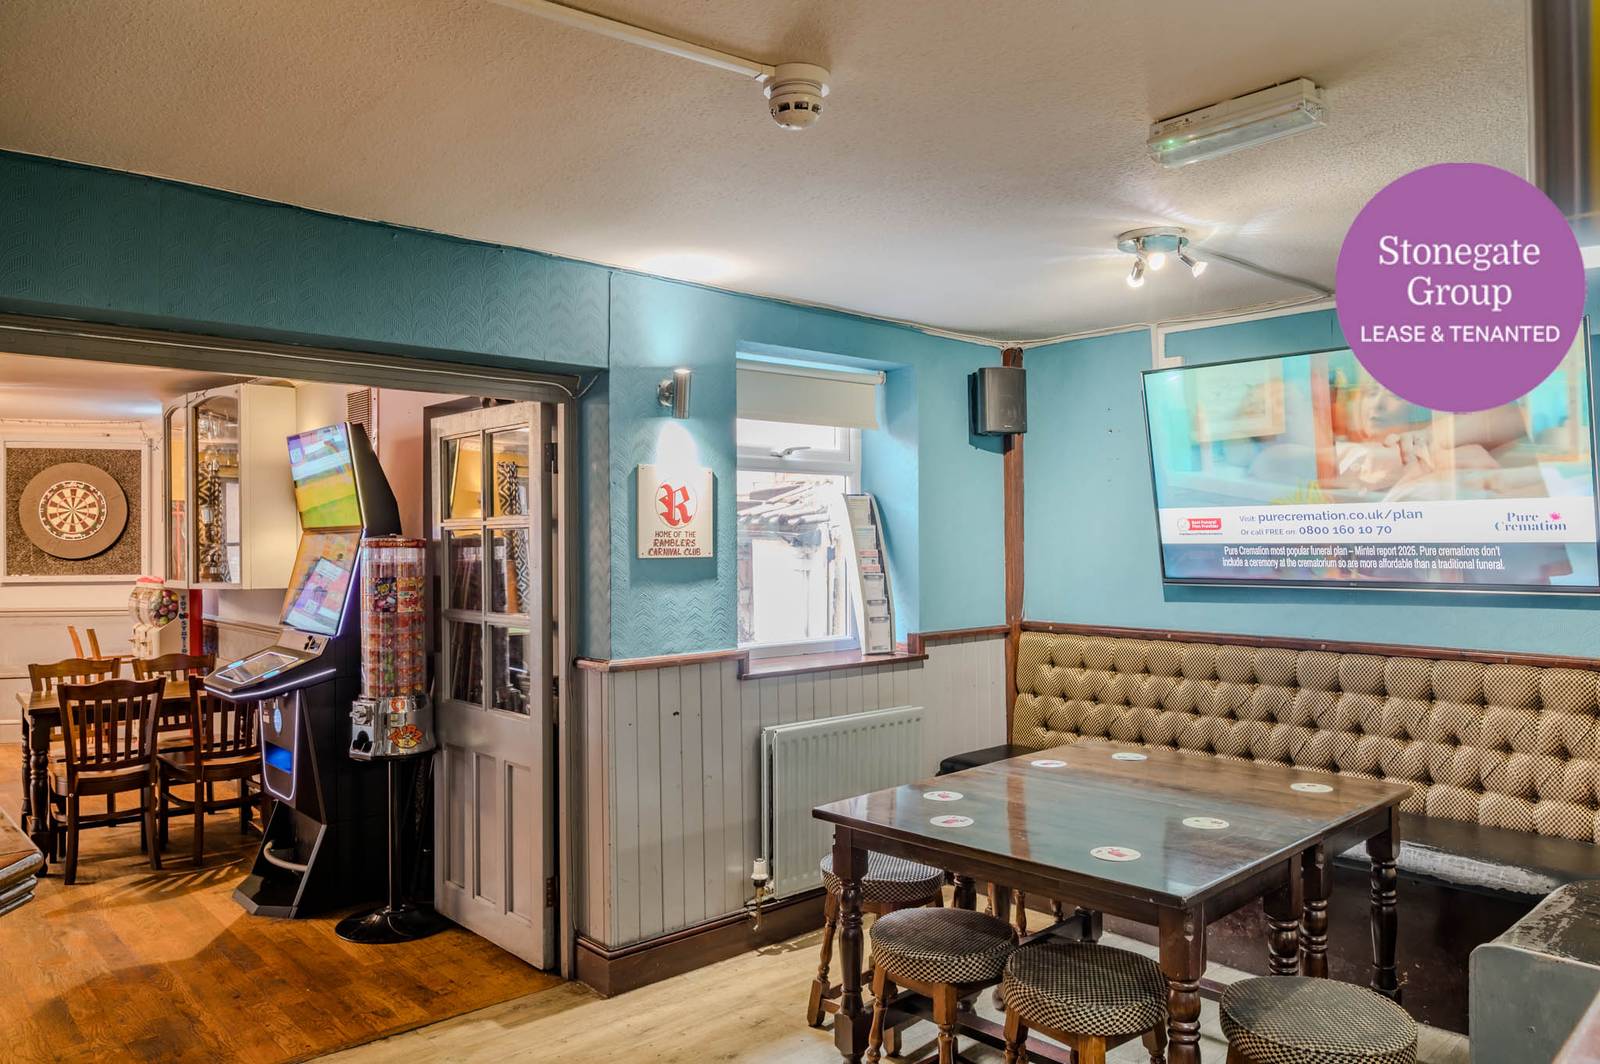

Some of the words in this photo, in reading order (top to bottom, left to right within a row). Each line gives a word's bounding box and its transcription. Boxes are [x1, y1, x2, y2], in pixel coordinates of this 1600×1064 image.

[658, 483, 693, 527] R
[1258, 508, 1423, 524] purecremation.co.uk/plan
[1507, 512, 1539, 522] Pure
[1241, 528, 1250, 536] Or
[1251, 528, 1264, 536] call
[1265, 528, 1284, 536] FREE
[1299, 525, 1329, 535] 0800
[1332, 524, 1355, 535] 160
[1359, 526, 1373, 535] 10
[1376, 525, 1392, 536] 70
[1494, 520, 1567, 531] Cremation
[653, 539, 696, 547] RAMBLERS
[648, 548, 682, 556] CARNIVAL
[683, 548, 702, 556] CLUB
[1224, 546, 1238, 556] Pure
[1240, 546, 1269, 556] Cremation
[1270, 546, 1285, 556] most
[1286, 546, 1309, 557] popular
[1311, 546, 1333, 556] funeral
[1334, 546, 1348, 557] plan
[1355, 545, 1375, 556] Mintel
[1377, 546, 1397, 557] report
[1420, 546, 1437, 556] Pure
[1438, 545, 1480, 556] cremations
[1481, 545, 1500, 556] don't
[1244, 559, 1249, 567] a
[1249, 559, 1278, 569] ceremony
[1279, 558, 1286, 567] at
[1286, 558, 1297, 567] the
[1297, 558, 1337, 568] crematorium
[1338, 560, 1347, 568] so
[1347, 560, 1359, 568] are
[1360, 560, 1378, 568] more
[1379, 558, 1413, 568] affordable
[1414, 559, 1430, 569] than
[1431, 560, 1437, 569] a
[1438, 558, 1475, 569] traditional
